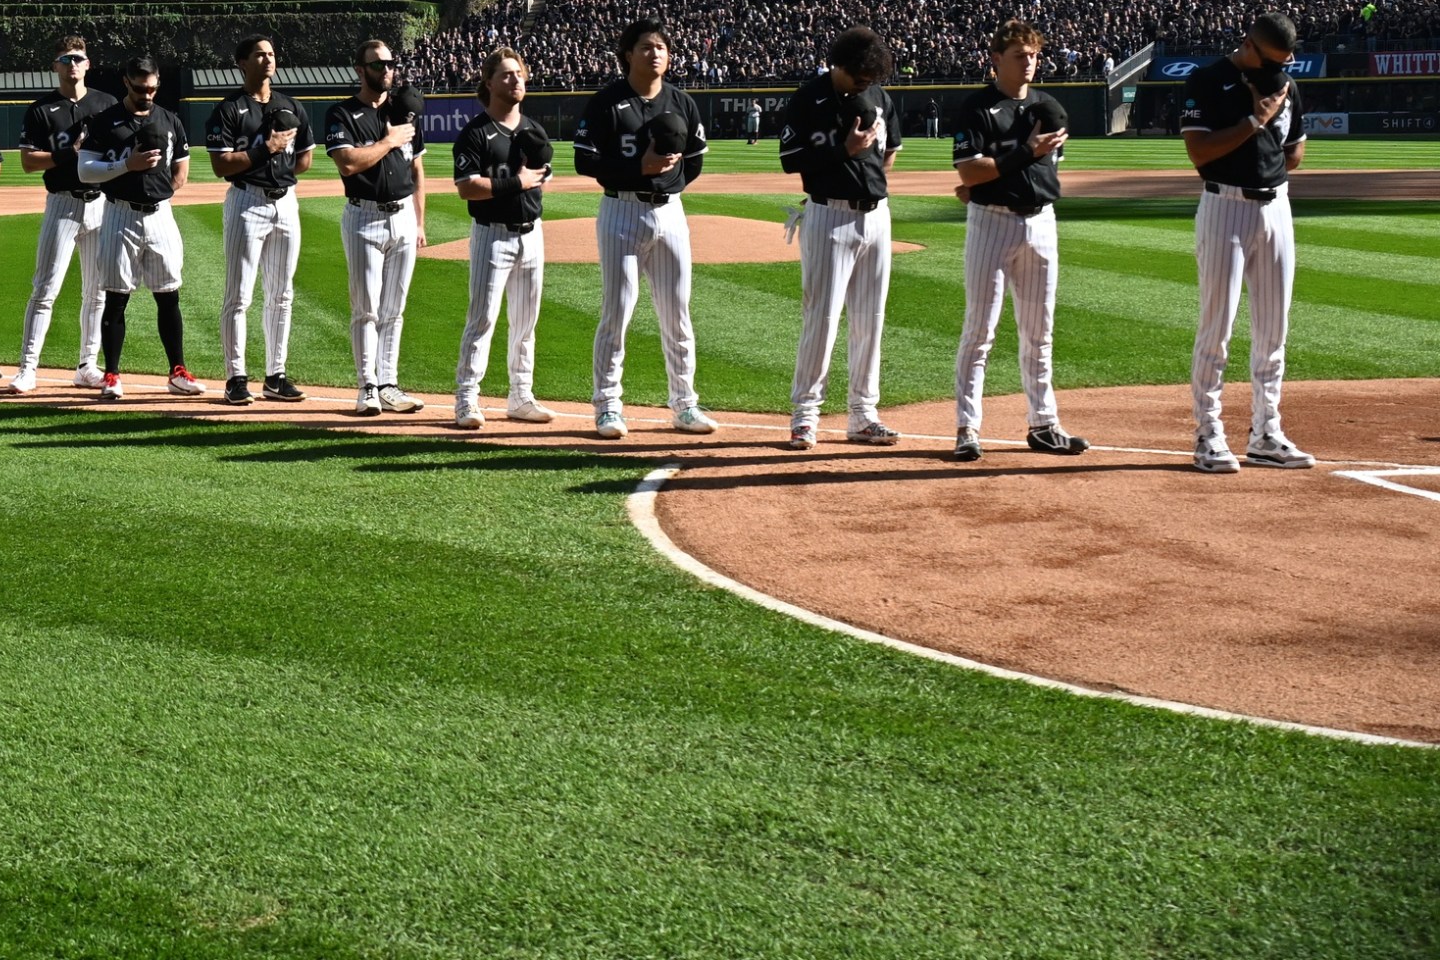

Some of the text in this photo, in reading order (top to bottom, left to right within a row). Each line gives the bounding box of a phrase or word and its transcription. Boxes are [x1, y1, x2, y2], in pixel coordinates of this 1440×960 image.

[1374, 52, 1440, 74] WHITT
[1382, 118, 1422, 129] SHIFT
[49, 131, 70, 151] 12
[327, 131, 344, 141] CME
[621, 134, 637, 158] 5
